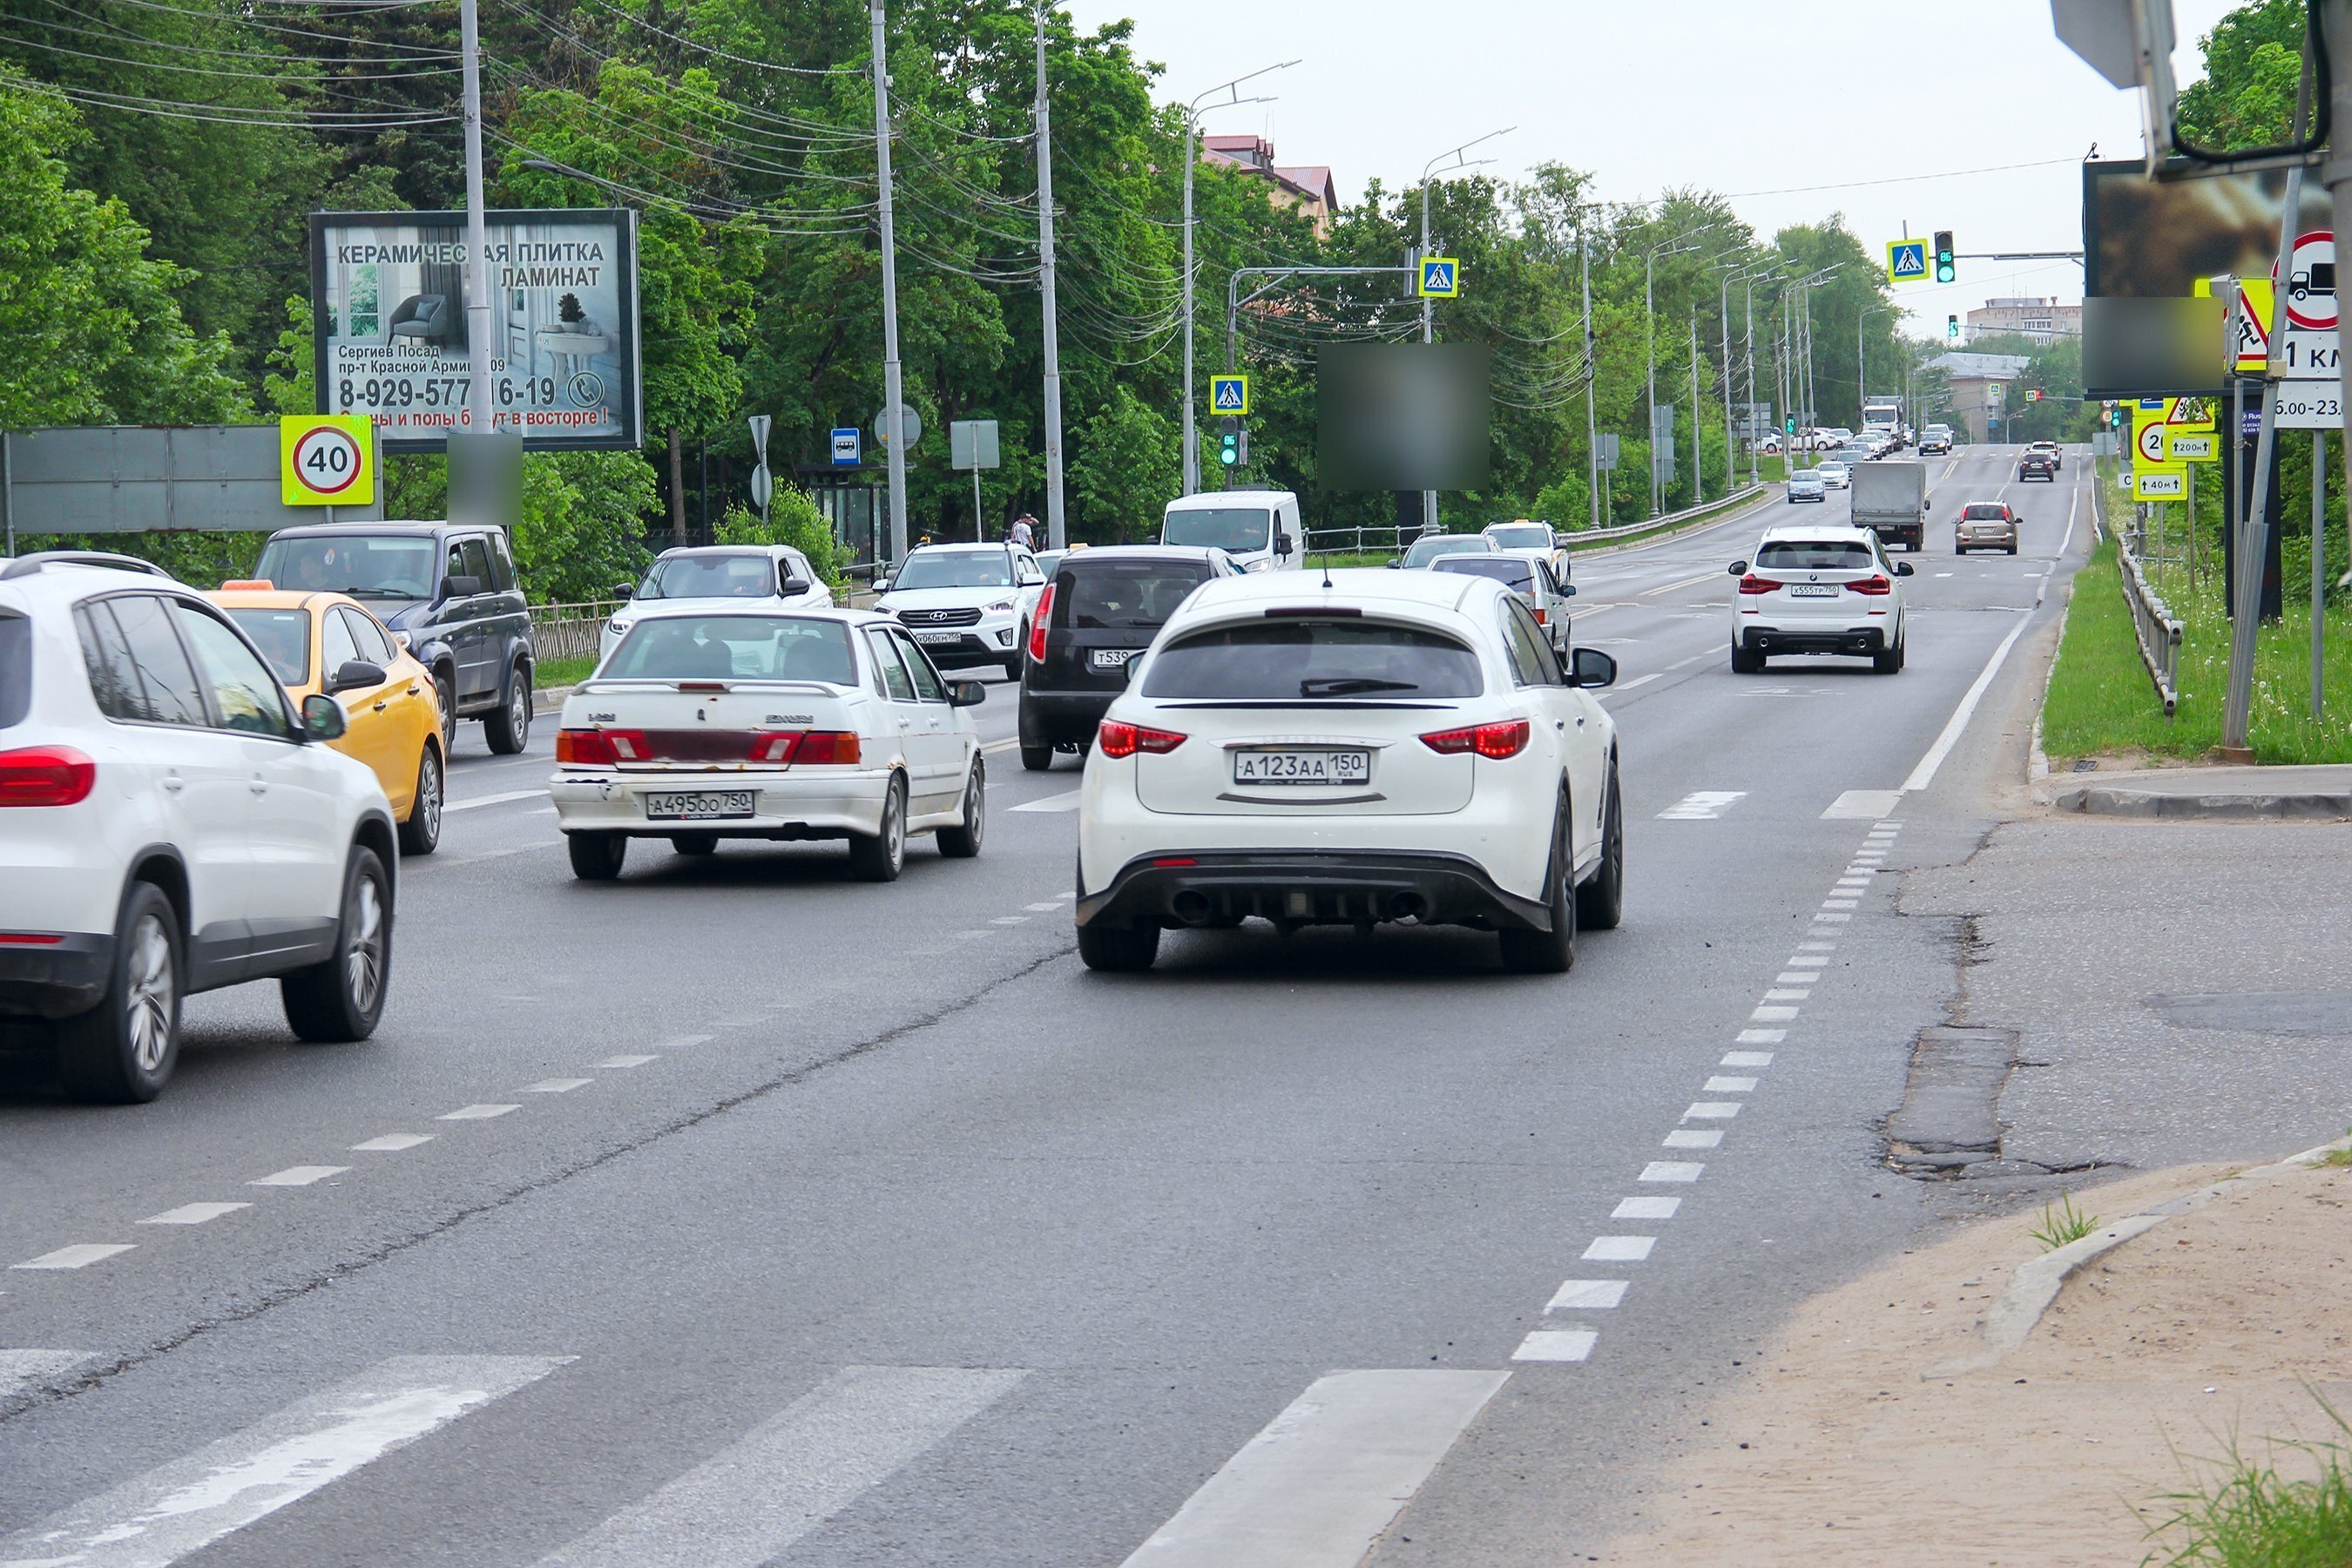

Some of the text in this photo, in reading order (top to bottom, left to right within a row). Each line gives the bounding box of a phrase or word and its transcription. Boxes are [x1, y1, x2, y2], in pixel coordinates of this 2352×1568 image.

[338, 242, 605, 263] КЕРАМИЧЕСАЯ ПЛИТКА
[501, 267, 600, 287] ЛАМИНАТ
[338, 344, 440, 361] Сергиев Посад
[2286, 341, 2295, 368] 1
[338, 359, 505, 375] пр-т Красной Арми 09
[2275, 400, 2343, 416] 6.00-23.
[398, 413, 407, 426] и
[413, 413, 456, 427] полы
[512, 413, 521, 425] в
[526, 412, 598, 429] восторге
[2149, 435, 2164, 449] 2
[307, 446, 348, 472] 40
[1098, 651, 1129, 663] Т539
[1243, 754, 1361, 776] А123АА 150
[653, 794, 749, 814] А495ОО 750
